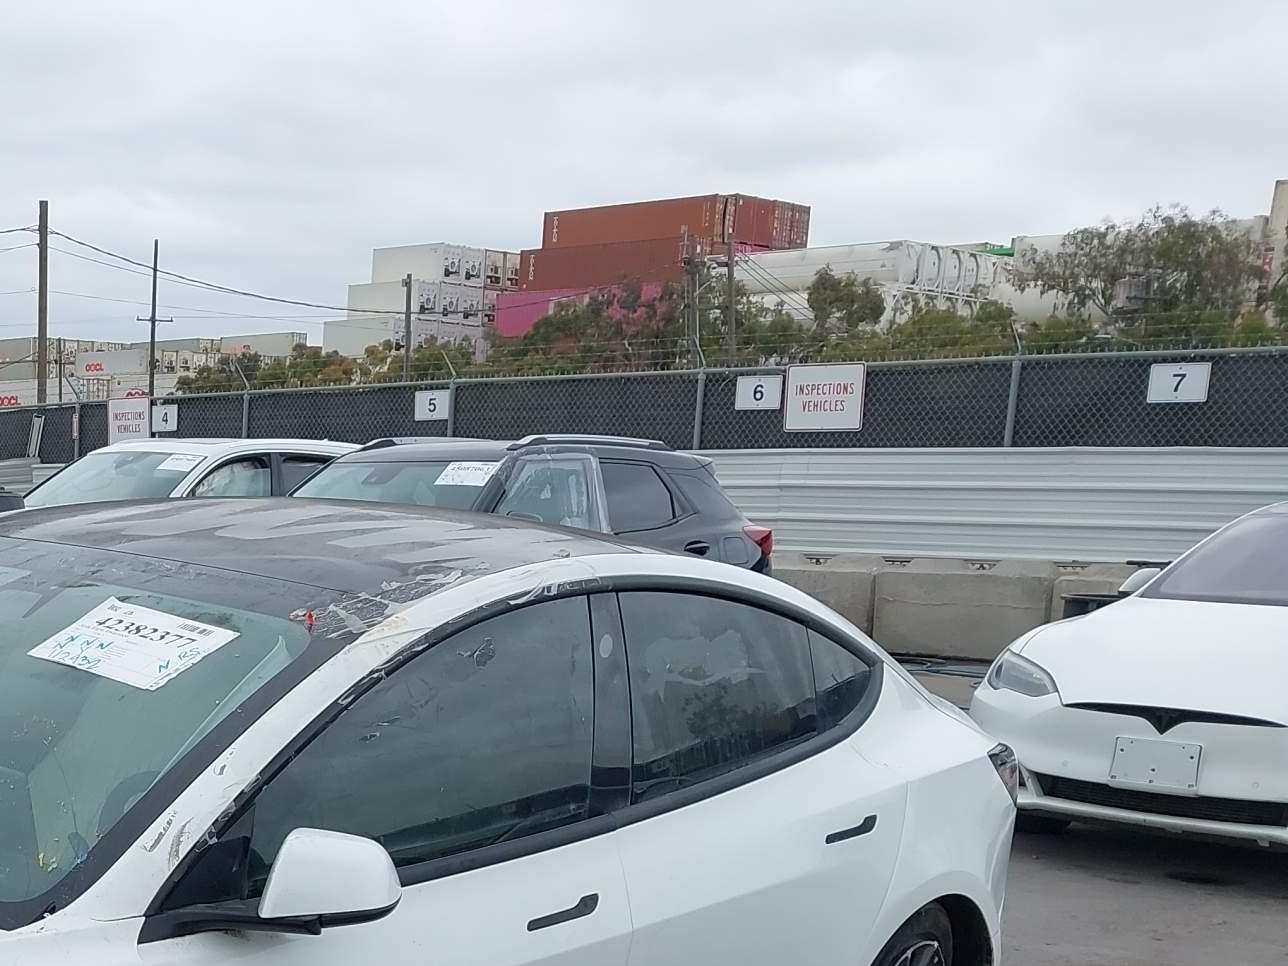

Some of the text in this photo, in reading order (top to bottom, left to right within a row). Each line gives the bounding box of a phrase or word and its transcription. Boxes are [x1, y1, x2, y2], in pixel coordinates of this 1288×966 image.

[795, 382, 855, 396] INSPECTIONS
[1172, 373, 1187, 393] 7
[752, 384, 765, 402] 6
[427, 397, 437, 413] 5
[801, 399, 846, 413] VEHICLES
[112, 410, 146, 422] INSPECTIONS
[161, 411, 169, 425] 4
[117, 424, 141, 434] VEHICLES
[96, 616, 198, 649] 42382377
